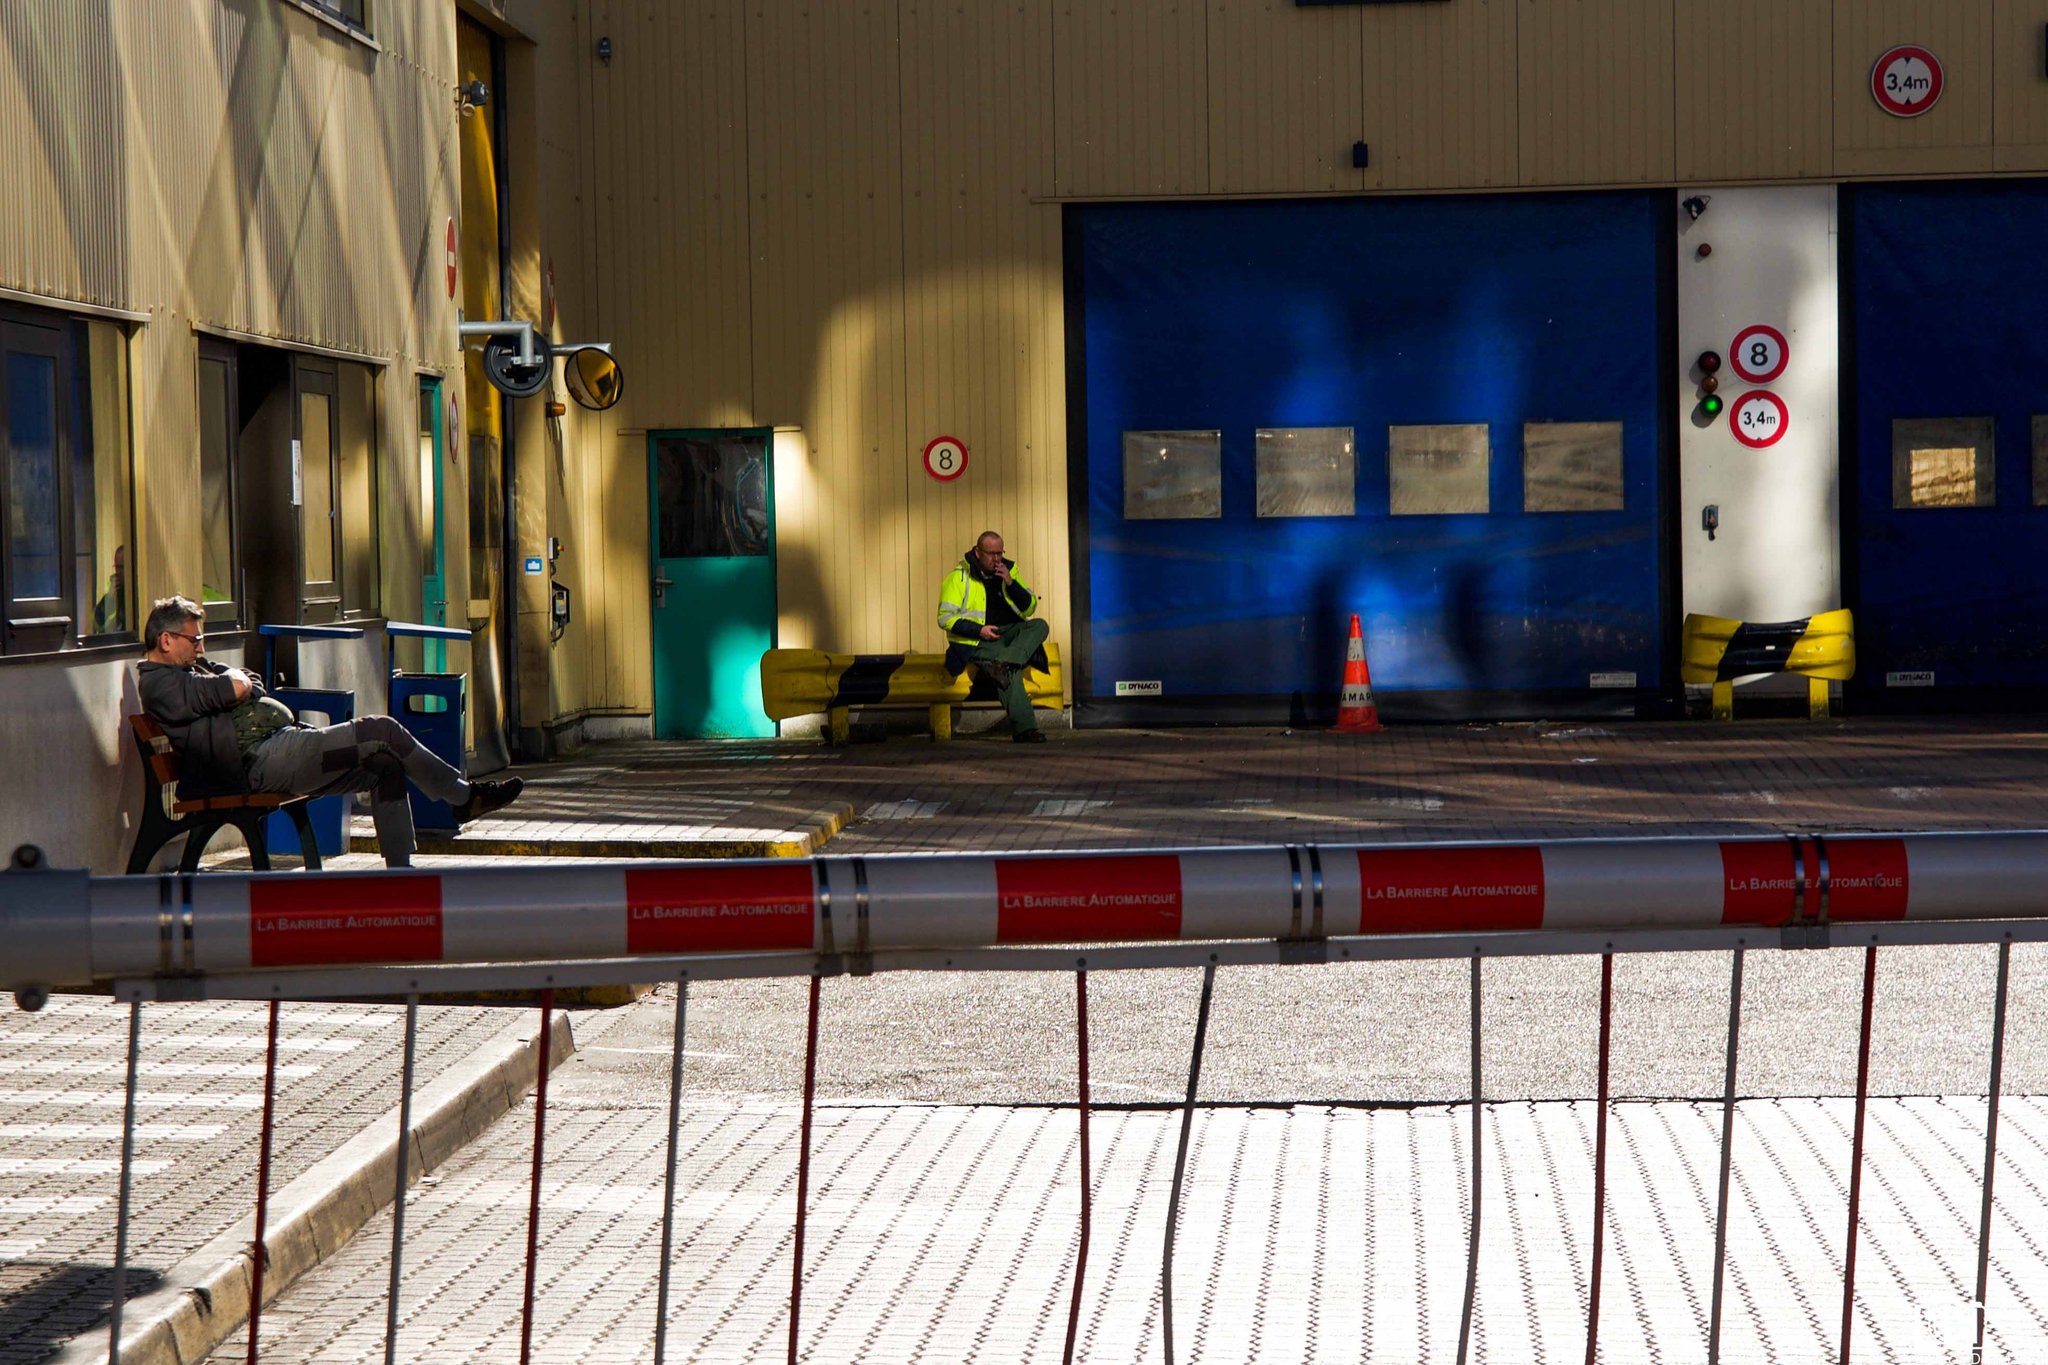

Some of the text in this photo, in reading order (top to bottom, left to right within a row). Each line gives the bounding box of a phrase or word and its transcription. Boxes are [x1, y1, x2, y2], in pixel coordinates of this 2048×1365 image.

[1887, 73, 1929, 93] 3,4m
[1750, 343, 1768, 367] 8
[1743, 410, 1776, 429] 3,4m
[939, 448, 953, 470] 8
[1387, 886, 1448, 899] BARRIERE
[1451, 884, 1538, 897] AUTOMATIQUE
[1750, 877, 1812, 890] BARRIEE
[1024, 895, 1087, 908] BARRIERE
[1088, 893, 1176, 906] AUTOMATIQUE
[653, 906, 717, 919] BARRIERE
[720, 903, 808, 917] AUTOMATIQUE
[278, 917, 343, 931] BARRIERE
[347, 915, 436, 928] AUTOMATIQUE
